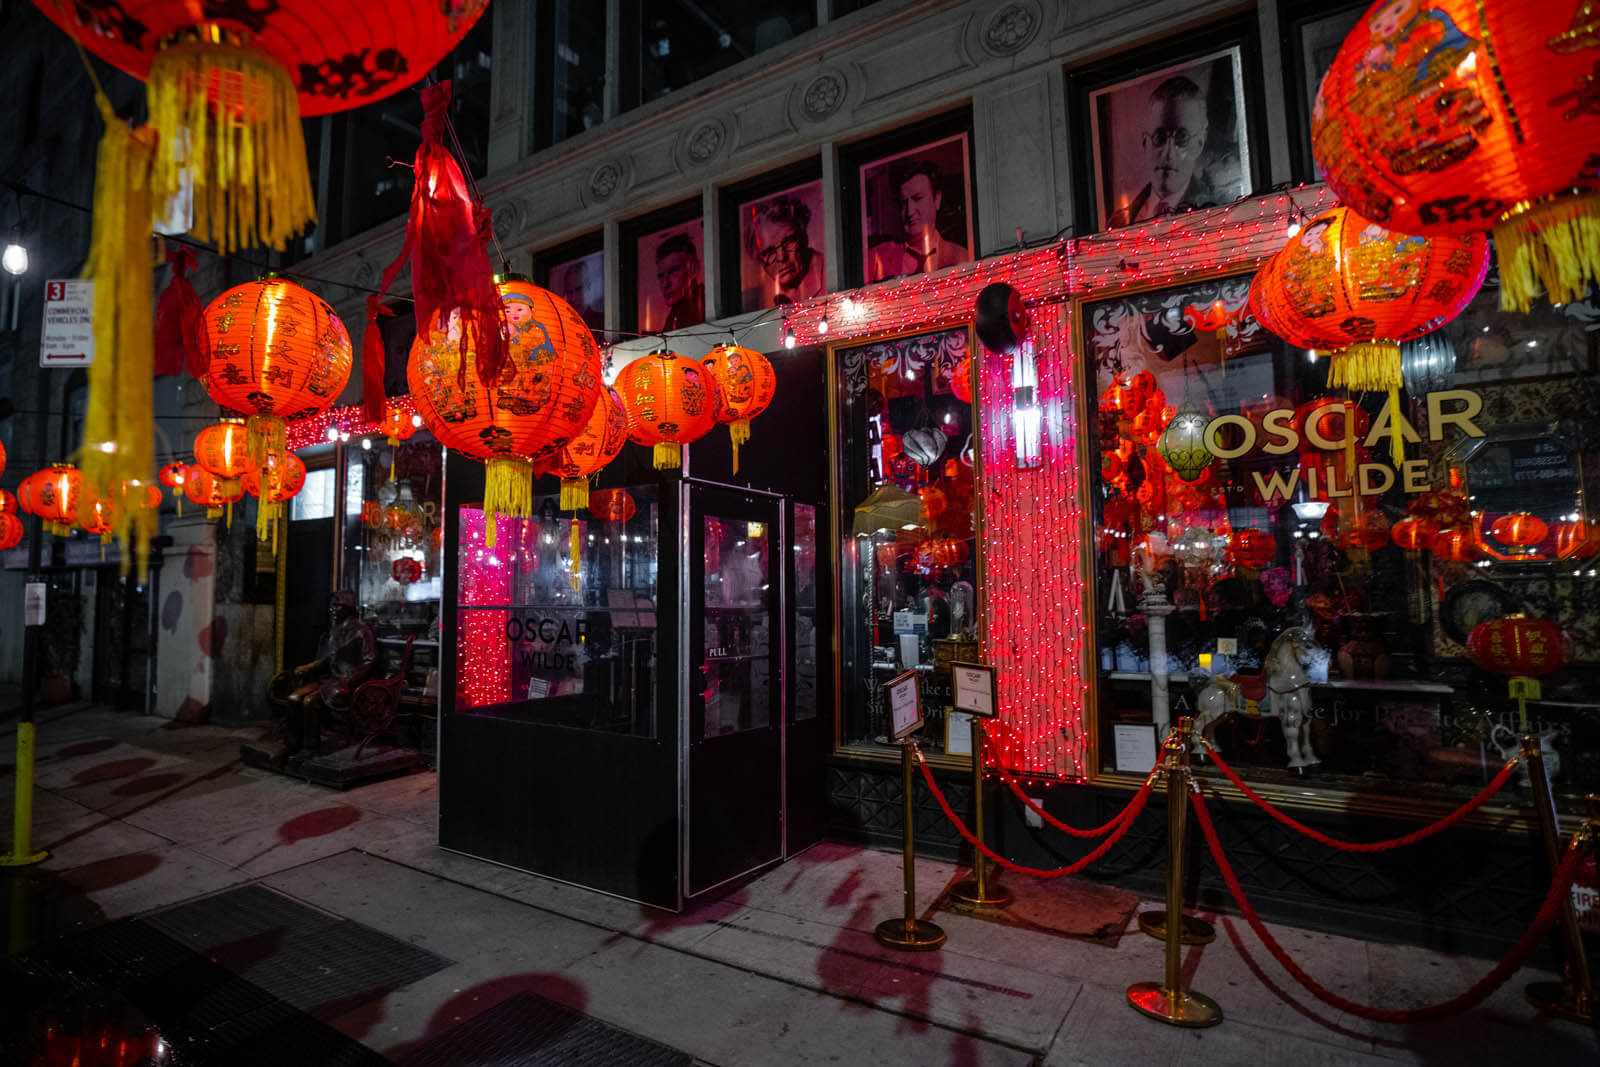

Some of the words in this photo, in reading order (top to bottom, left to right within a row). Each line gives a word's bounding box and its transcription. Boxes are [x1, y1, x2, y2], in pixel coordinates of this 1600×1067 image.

[51, 282, 62, 300] 3
[1203, 389, 1486, 459] OSCAR
[1252, 459, 1432, 501] WILDE
[506, 618, 591, 644] OSCAR
[521, 653, 576, 671] WILDE
[709, 648, 727, 657] PULL
